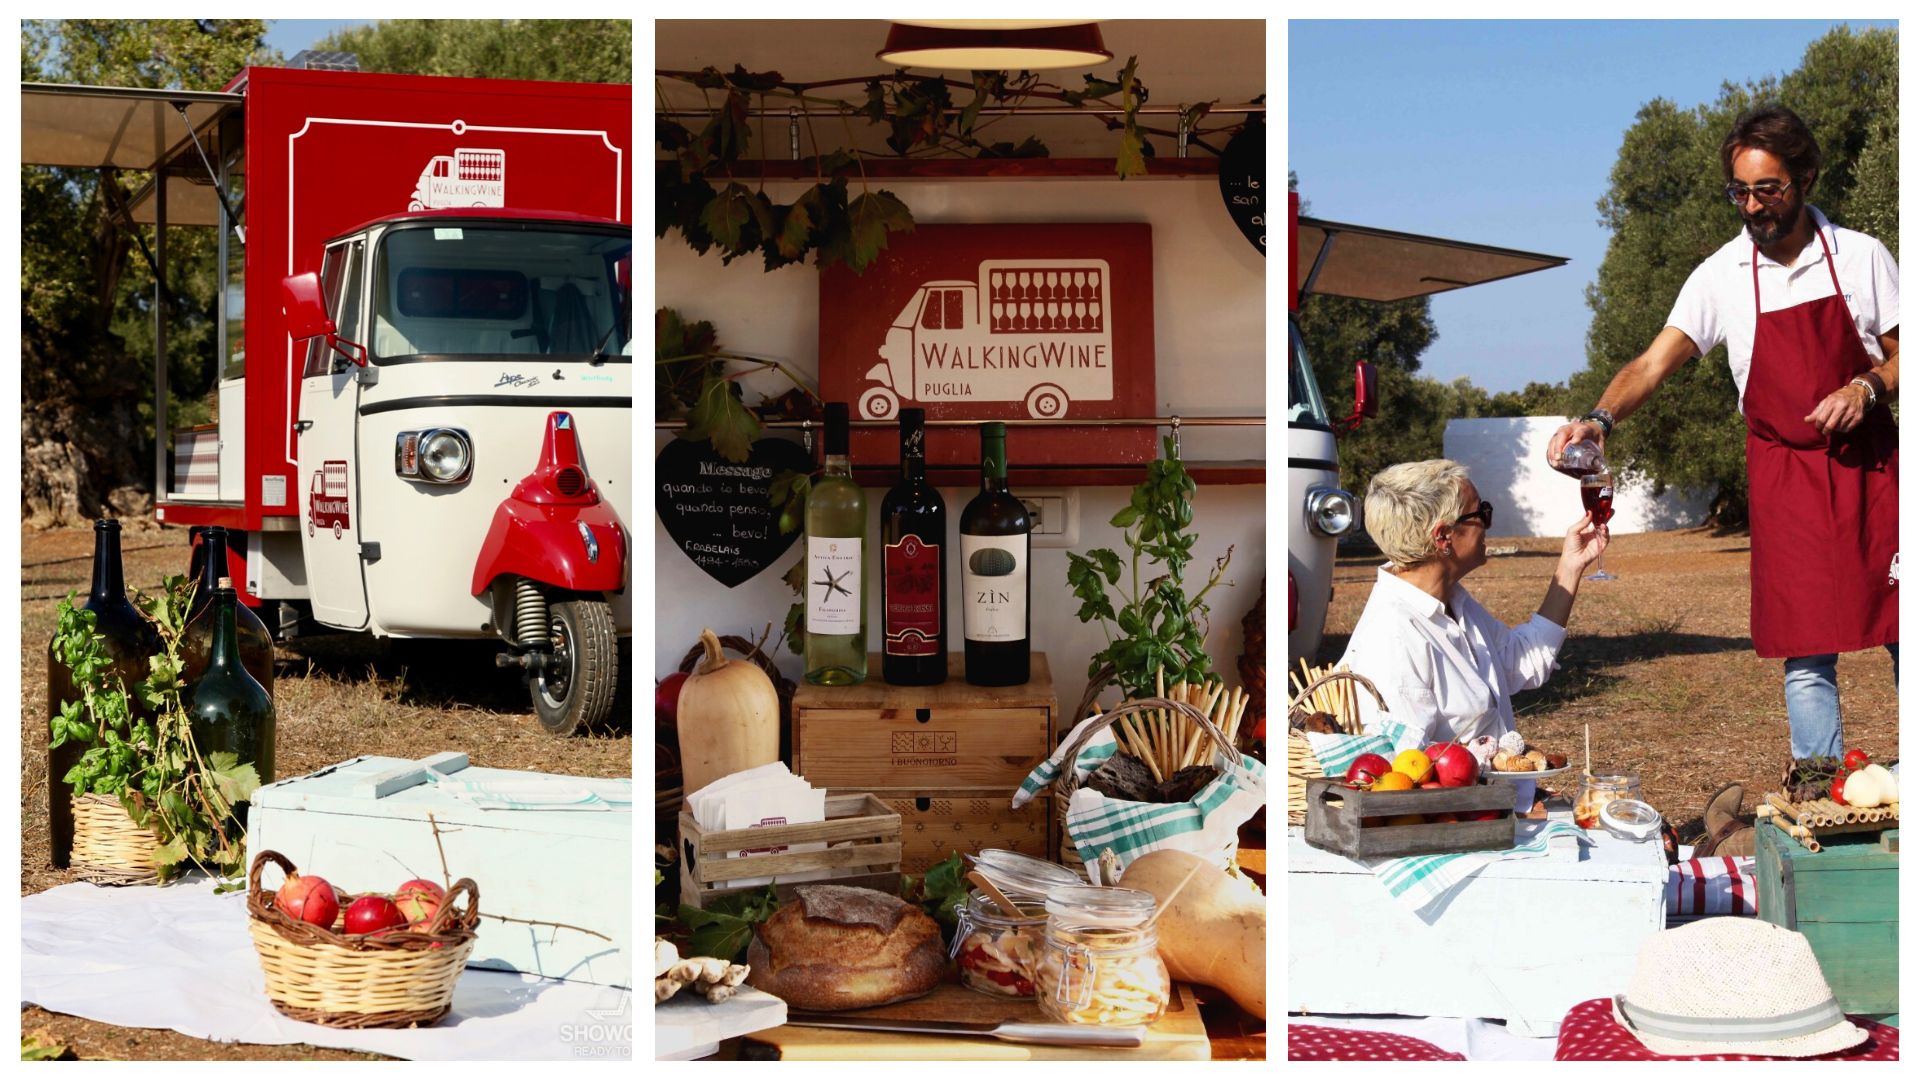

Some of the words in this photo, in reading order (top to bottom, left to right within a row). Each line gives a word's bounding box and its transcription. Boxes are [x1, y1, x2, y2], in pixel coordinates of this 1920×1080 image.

[924, 383, 972, 396] PUGLIA
[699, 461, 773, 480] Message
[662, 481, 713, 499] quando
[720, 482, 733, 494] io
[675, 500, 724, 517] quando
[732, 523, 768, 540] bevo!
[977, 589, 1010, 604] ZÌN
[897, 758, 957, 766] BUONGIORNO
